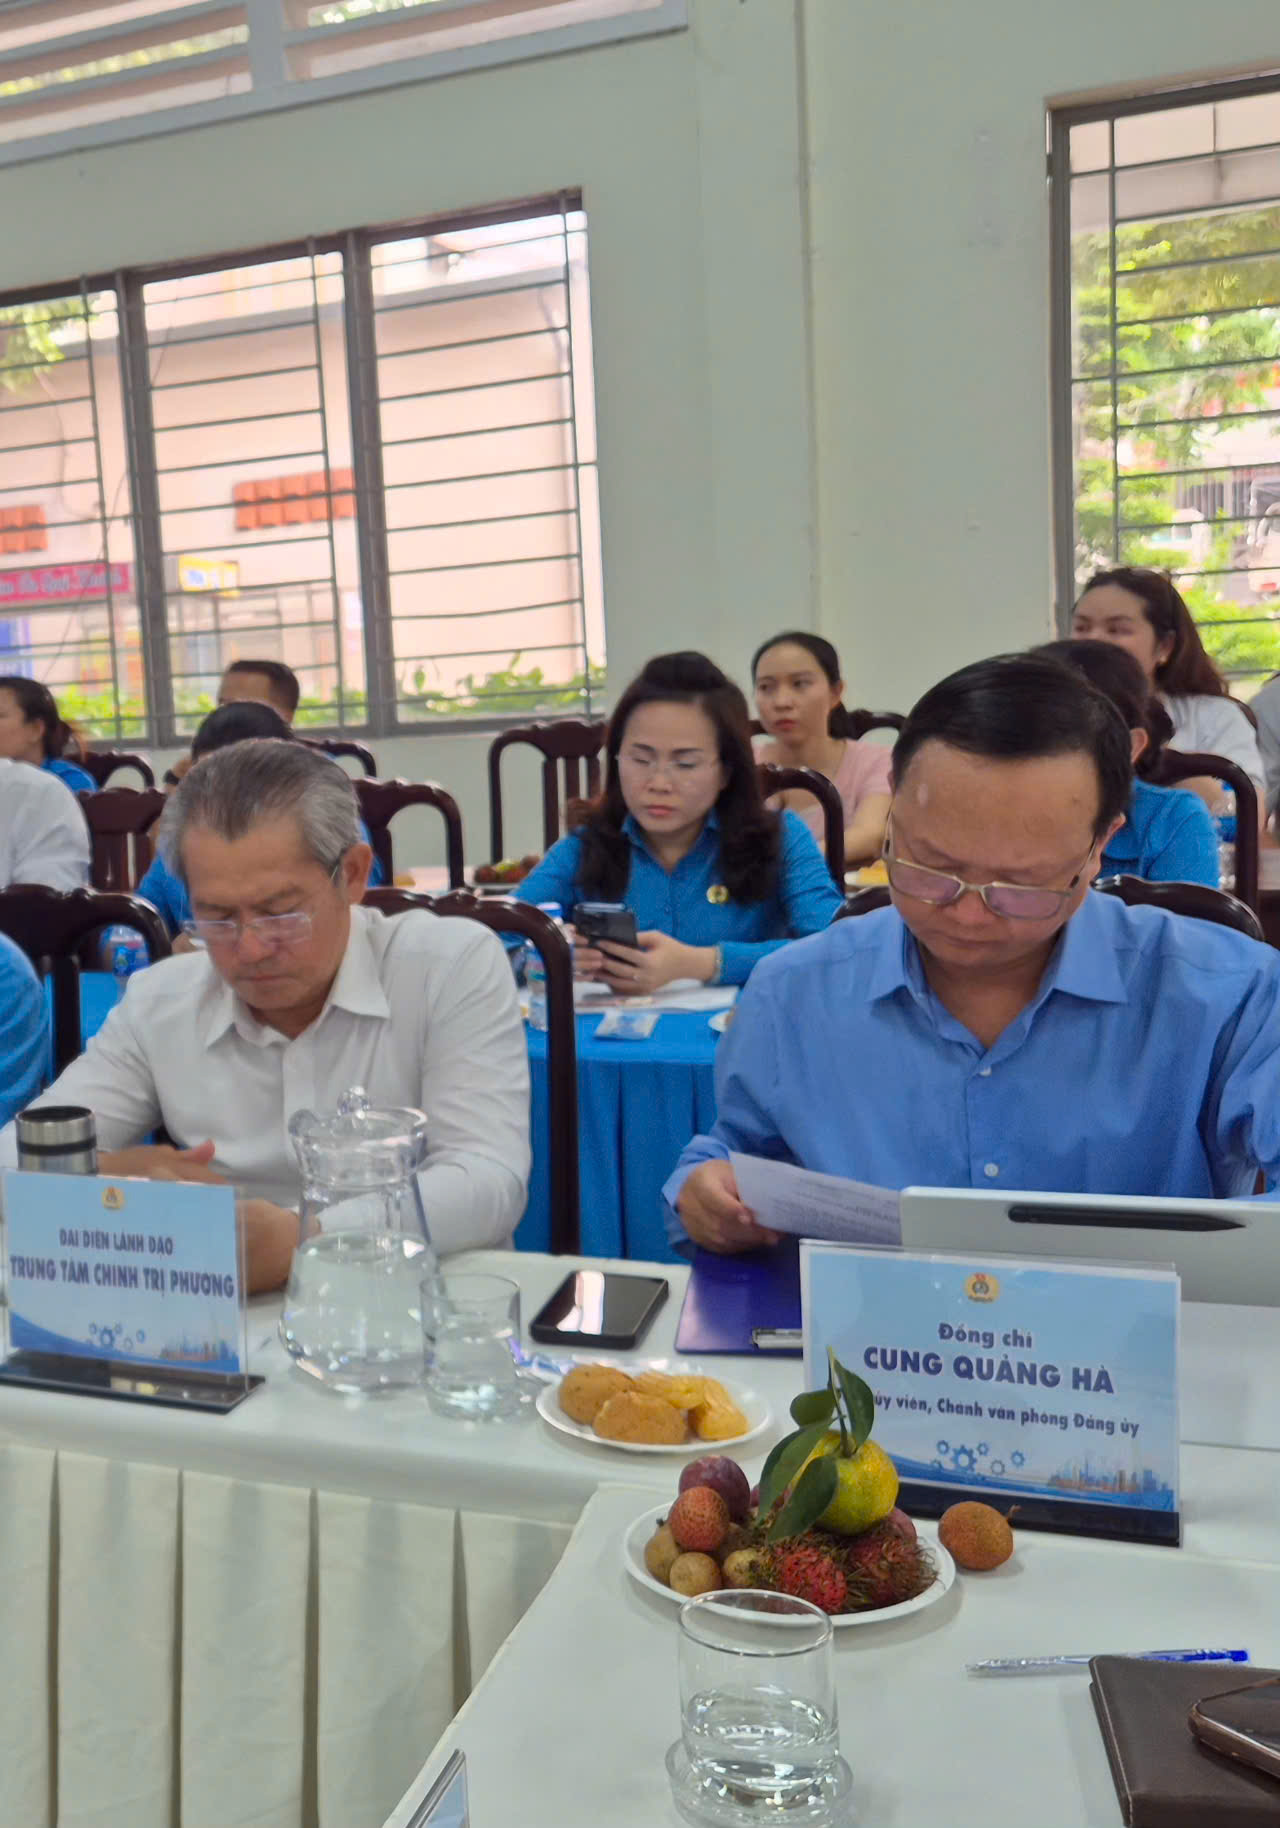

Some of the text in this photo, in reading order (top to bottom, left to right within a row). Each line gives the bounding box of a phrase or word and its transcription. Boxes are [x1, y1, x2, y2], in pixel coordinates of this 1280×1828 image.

[10, 1255, 57, 1281] TRUNG
[863, 1345, 944, 1376] CUNG
[952, 1352, 1062, 1389] QUẢNG
